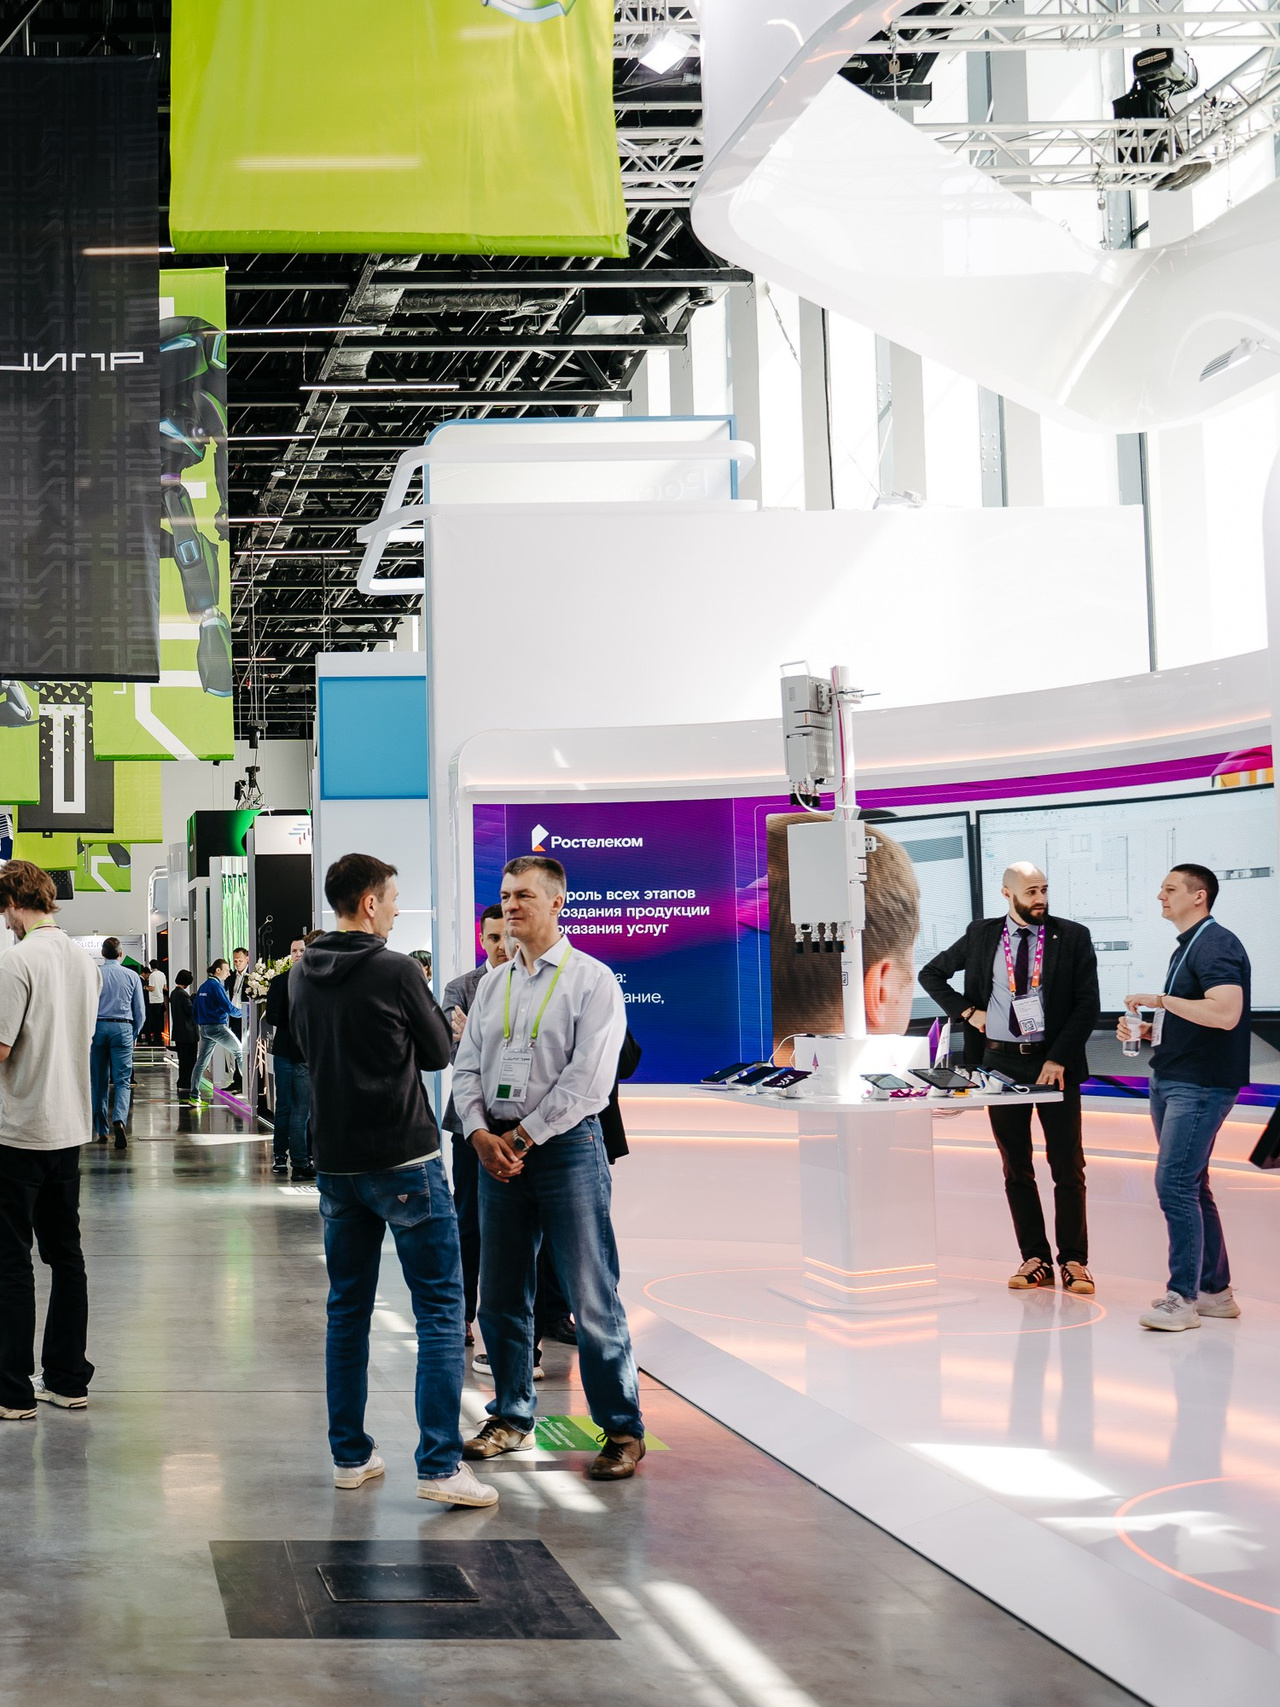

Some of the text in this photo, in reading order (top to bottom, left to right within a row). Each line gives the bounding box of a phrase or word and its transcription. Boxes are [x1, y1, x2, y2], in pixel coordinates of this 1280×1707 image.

[550, 836, 643, 849] Ростелеком
[566, 888, 696, 904] роль всех этапов
[557, 905, 710, 920] оздания продукции
[626, 922, 669, 937] услуг
[623, 992, 665, 1005] ание,
